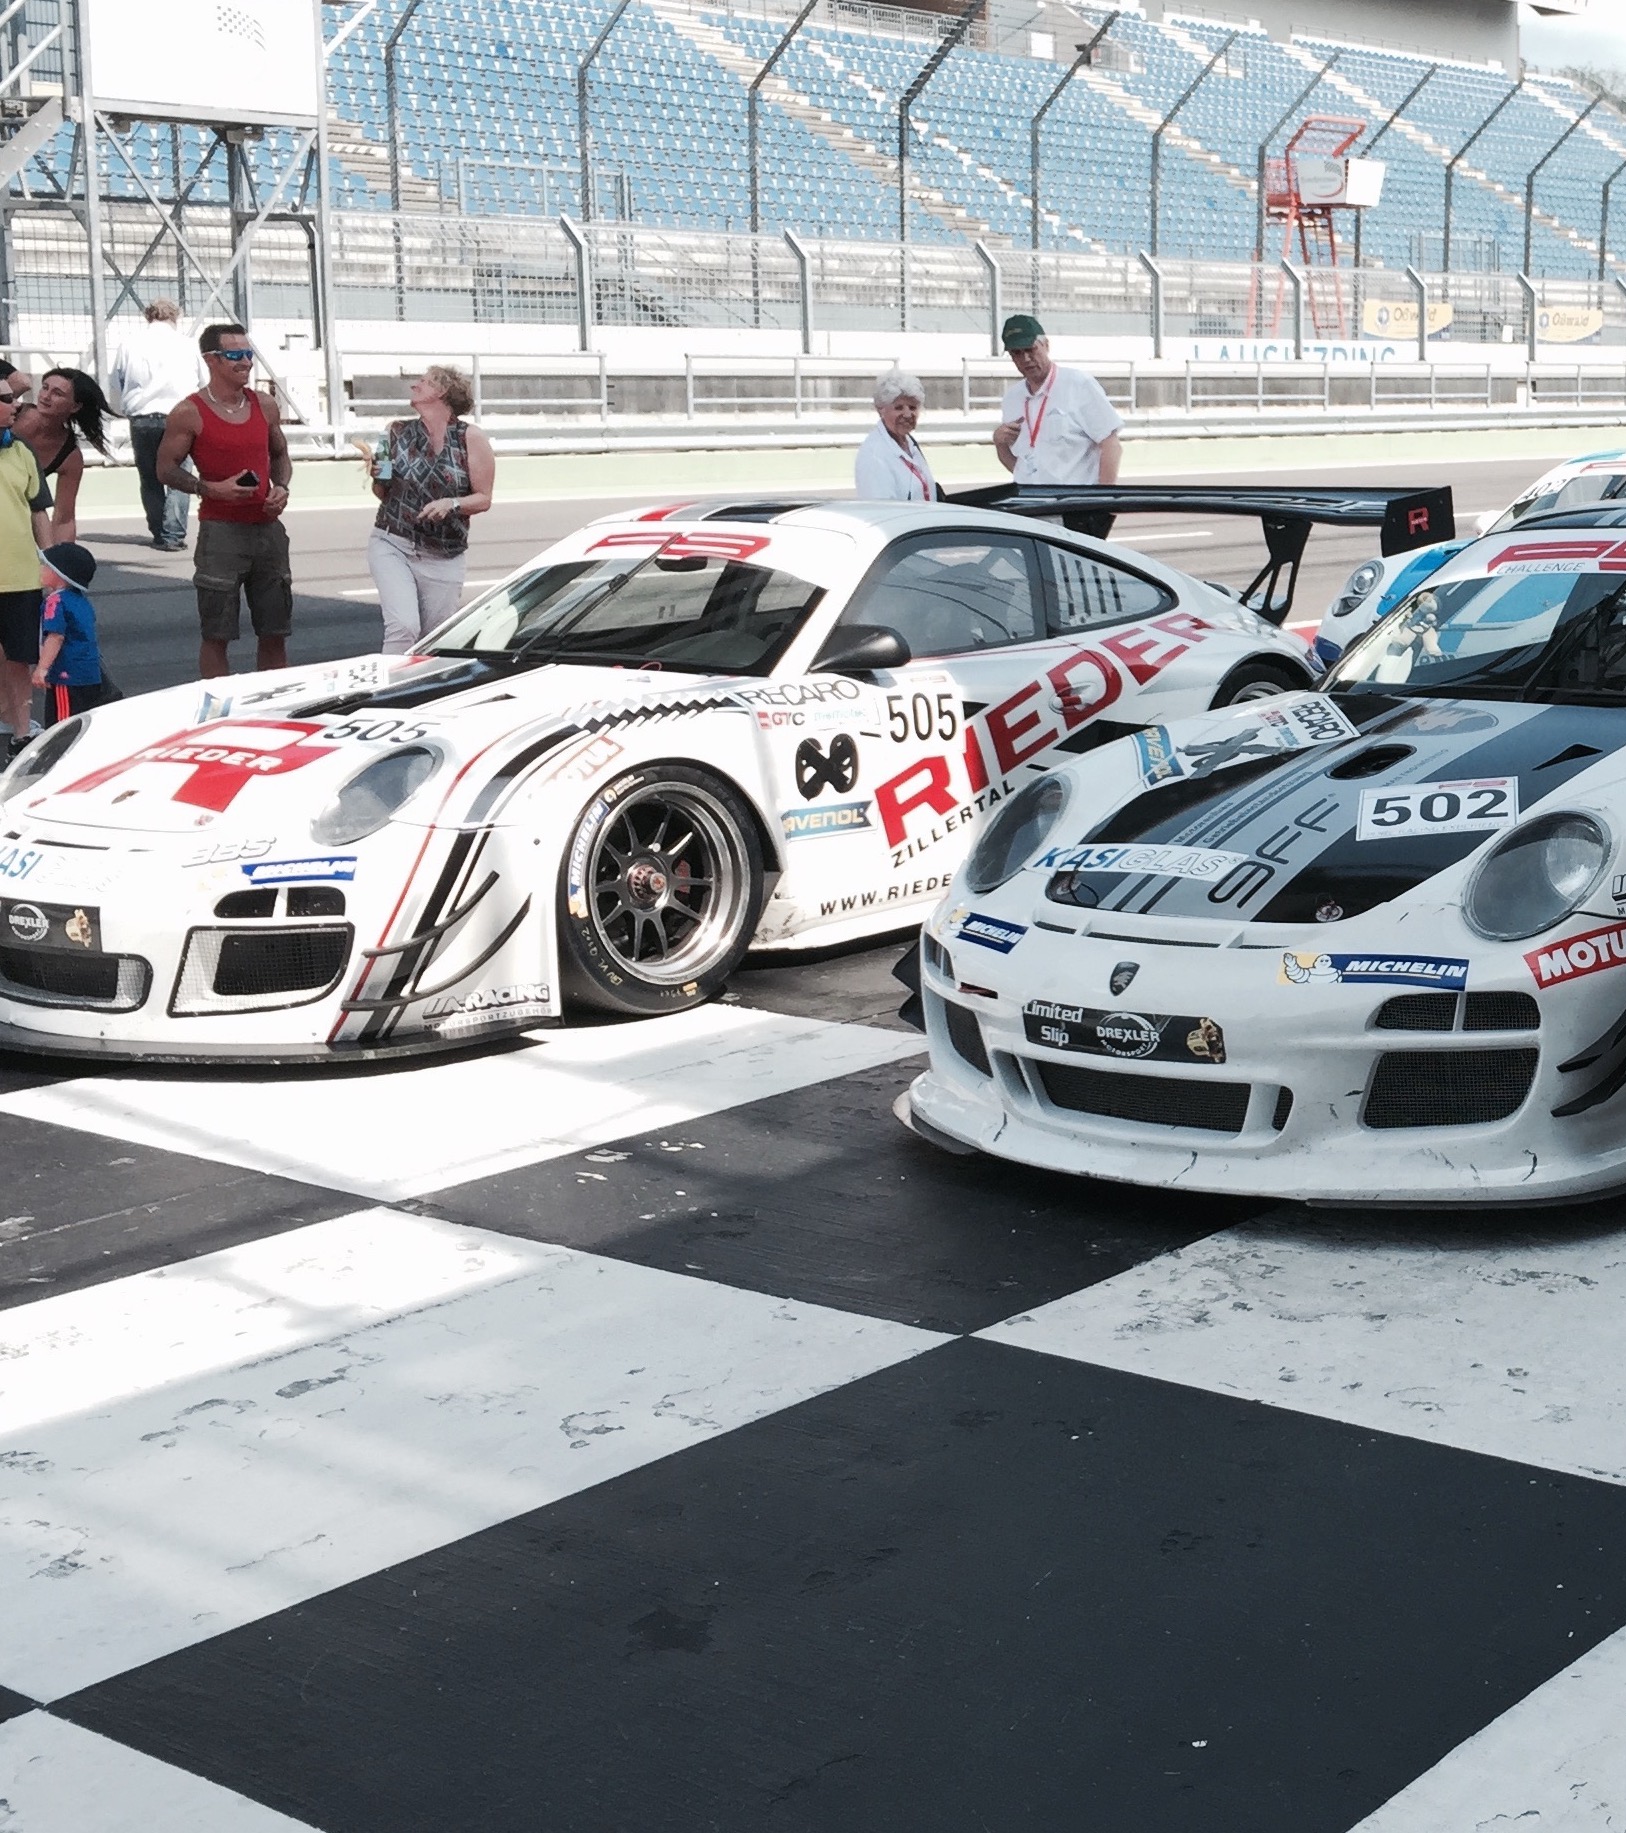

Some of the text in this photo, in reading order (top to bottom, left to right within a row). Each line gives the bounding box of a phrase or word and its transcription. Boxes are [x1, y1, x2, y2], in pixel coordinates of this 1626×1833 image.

[1498, 561, 1586, 575] CHALLENGE
[738, 680, 860, 706] RECARO
[886, 692, 958, 743] 505
[322, 718, 442, 743] 505
[875, 612, 1217, 849] RIEDER
[134, 747, 284, 772] RIEDER
[1371, 788, 1509, 827] 502
[781, 808, 864, 833] AVENOL
[890, 779, 1016, 869] ZILLERTAL
[571, 802, 605, 886] MICHELIN
[0, 846, 44, 880] ASI
[820, 873, 953, 917] WWW.RIEDE
[971, 921, 1023, 944] MICHELIN
[1345, 959, 1467, 978] MICHELIN
[1023, 1000, 1084, 1023] Limited
[1041, 1025, 1069, 1046] Slip
[1096, 1026, 1161, 1043] DREXLER
